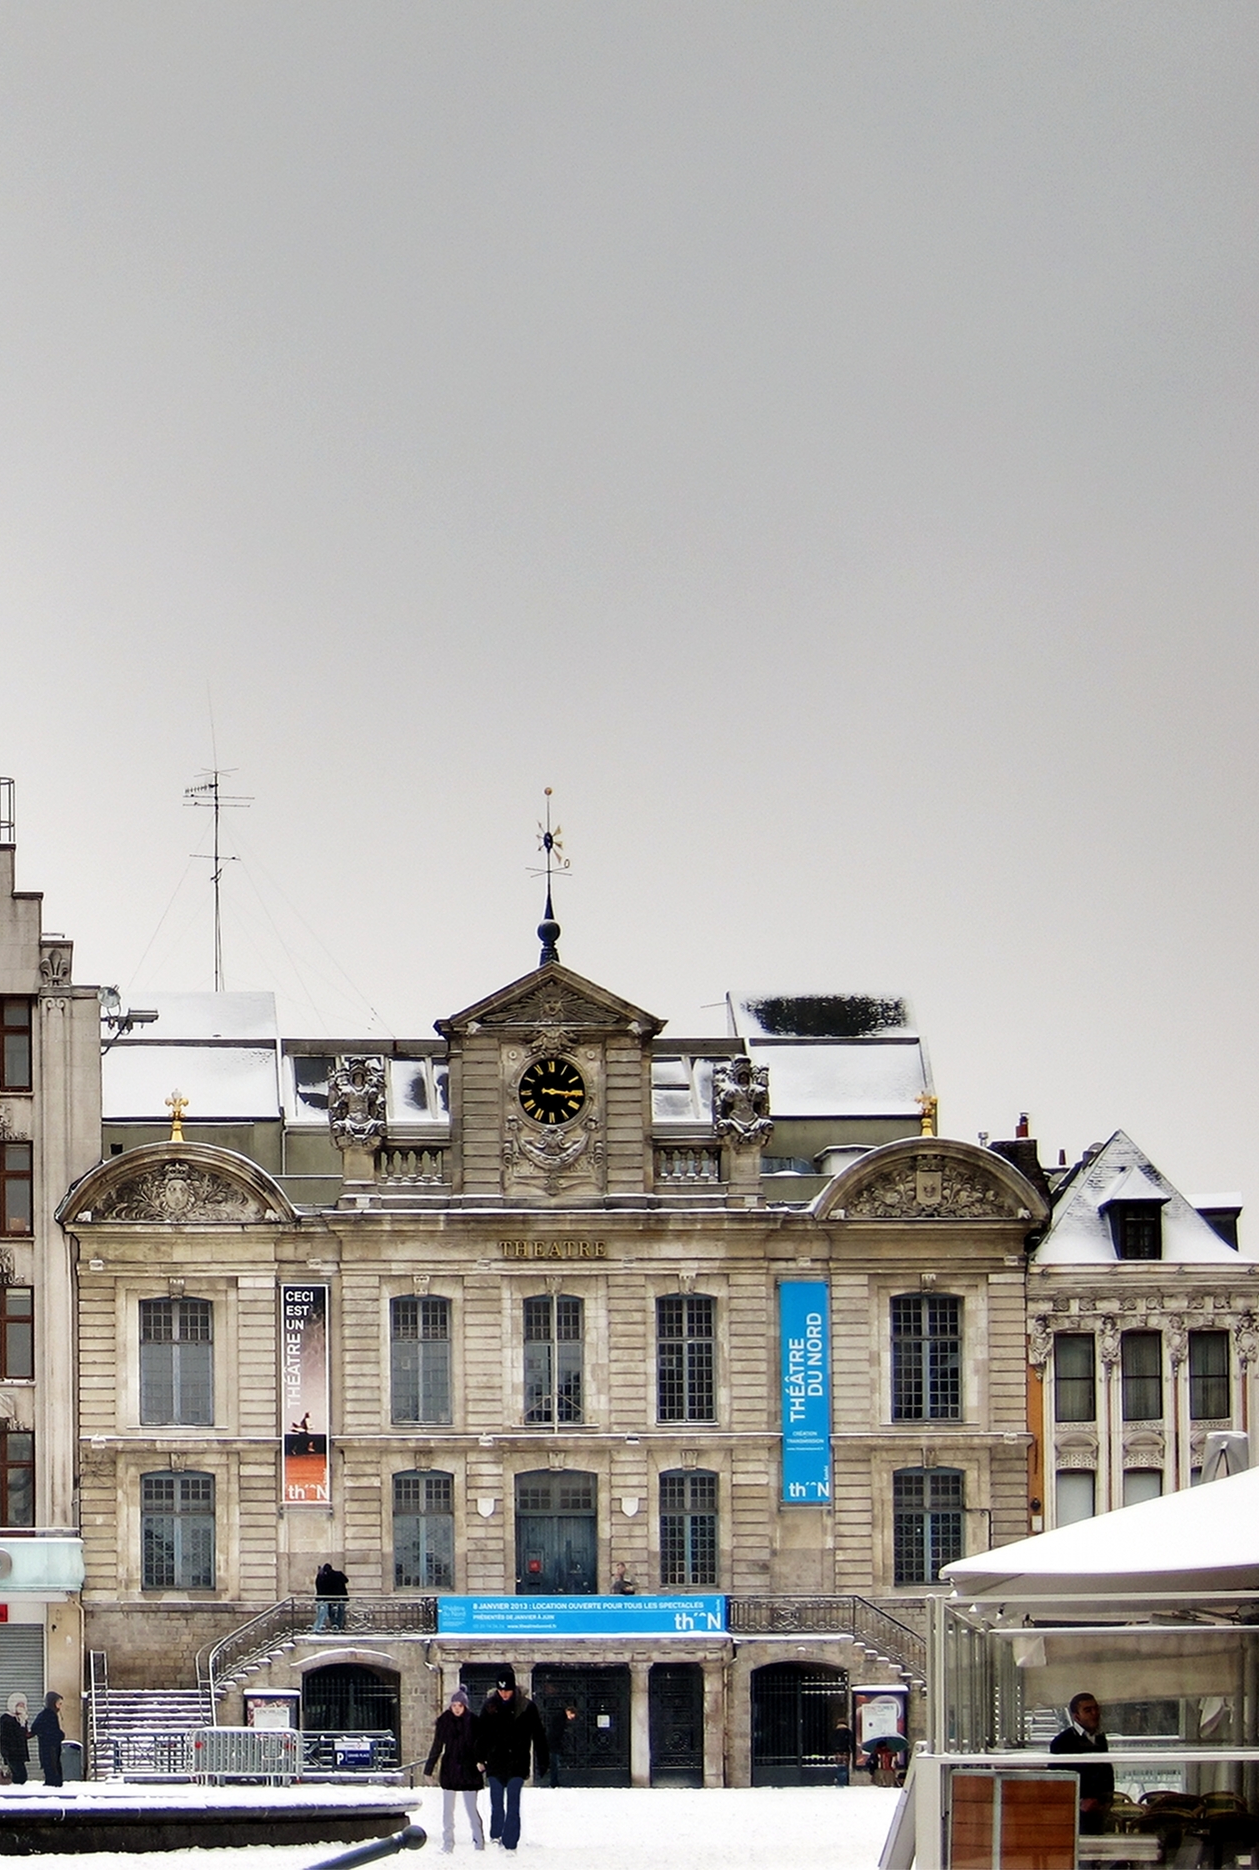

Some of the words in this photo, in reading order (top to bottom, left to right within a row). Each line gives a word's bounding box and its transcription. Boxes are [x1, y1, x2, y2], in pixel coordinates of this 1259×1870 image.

[498, 1240, 608, 1258] THEATRE
[285, 1290, 314, 1302] CECI
[286, 1304, 310, 1317] EST
[285, 1319, 304, 1330] UN
[805, 1312, 823, 1366] NORD
[283, 1333, 301, 1409] THÉÂTRE
[784, 1337, 806, 1424] THÉÂTRE
[806, 1370, 824, 1397] DU
[478, 1602, 510, 1611] JANVIER
[510, 1602, 528, 1611] 2013
[532, 1602, 568, 1611] LOCATION
[568, 1602, 602, 1611] OUVERTE
[602, 1602, 623, 1610] POUR
[623, 1602, 643, 1610] TOUS
[643, 1602, 658, 1610] LES
[658, 1601, 704, 1610] SPECTACLES
[336, 1751, 345, 1766] P
